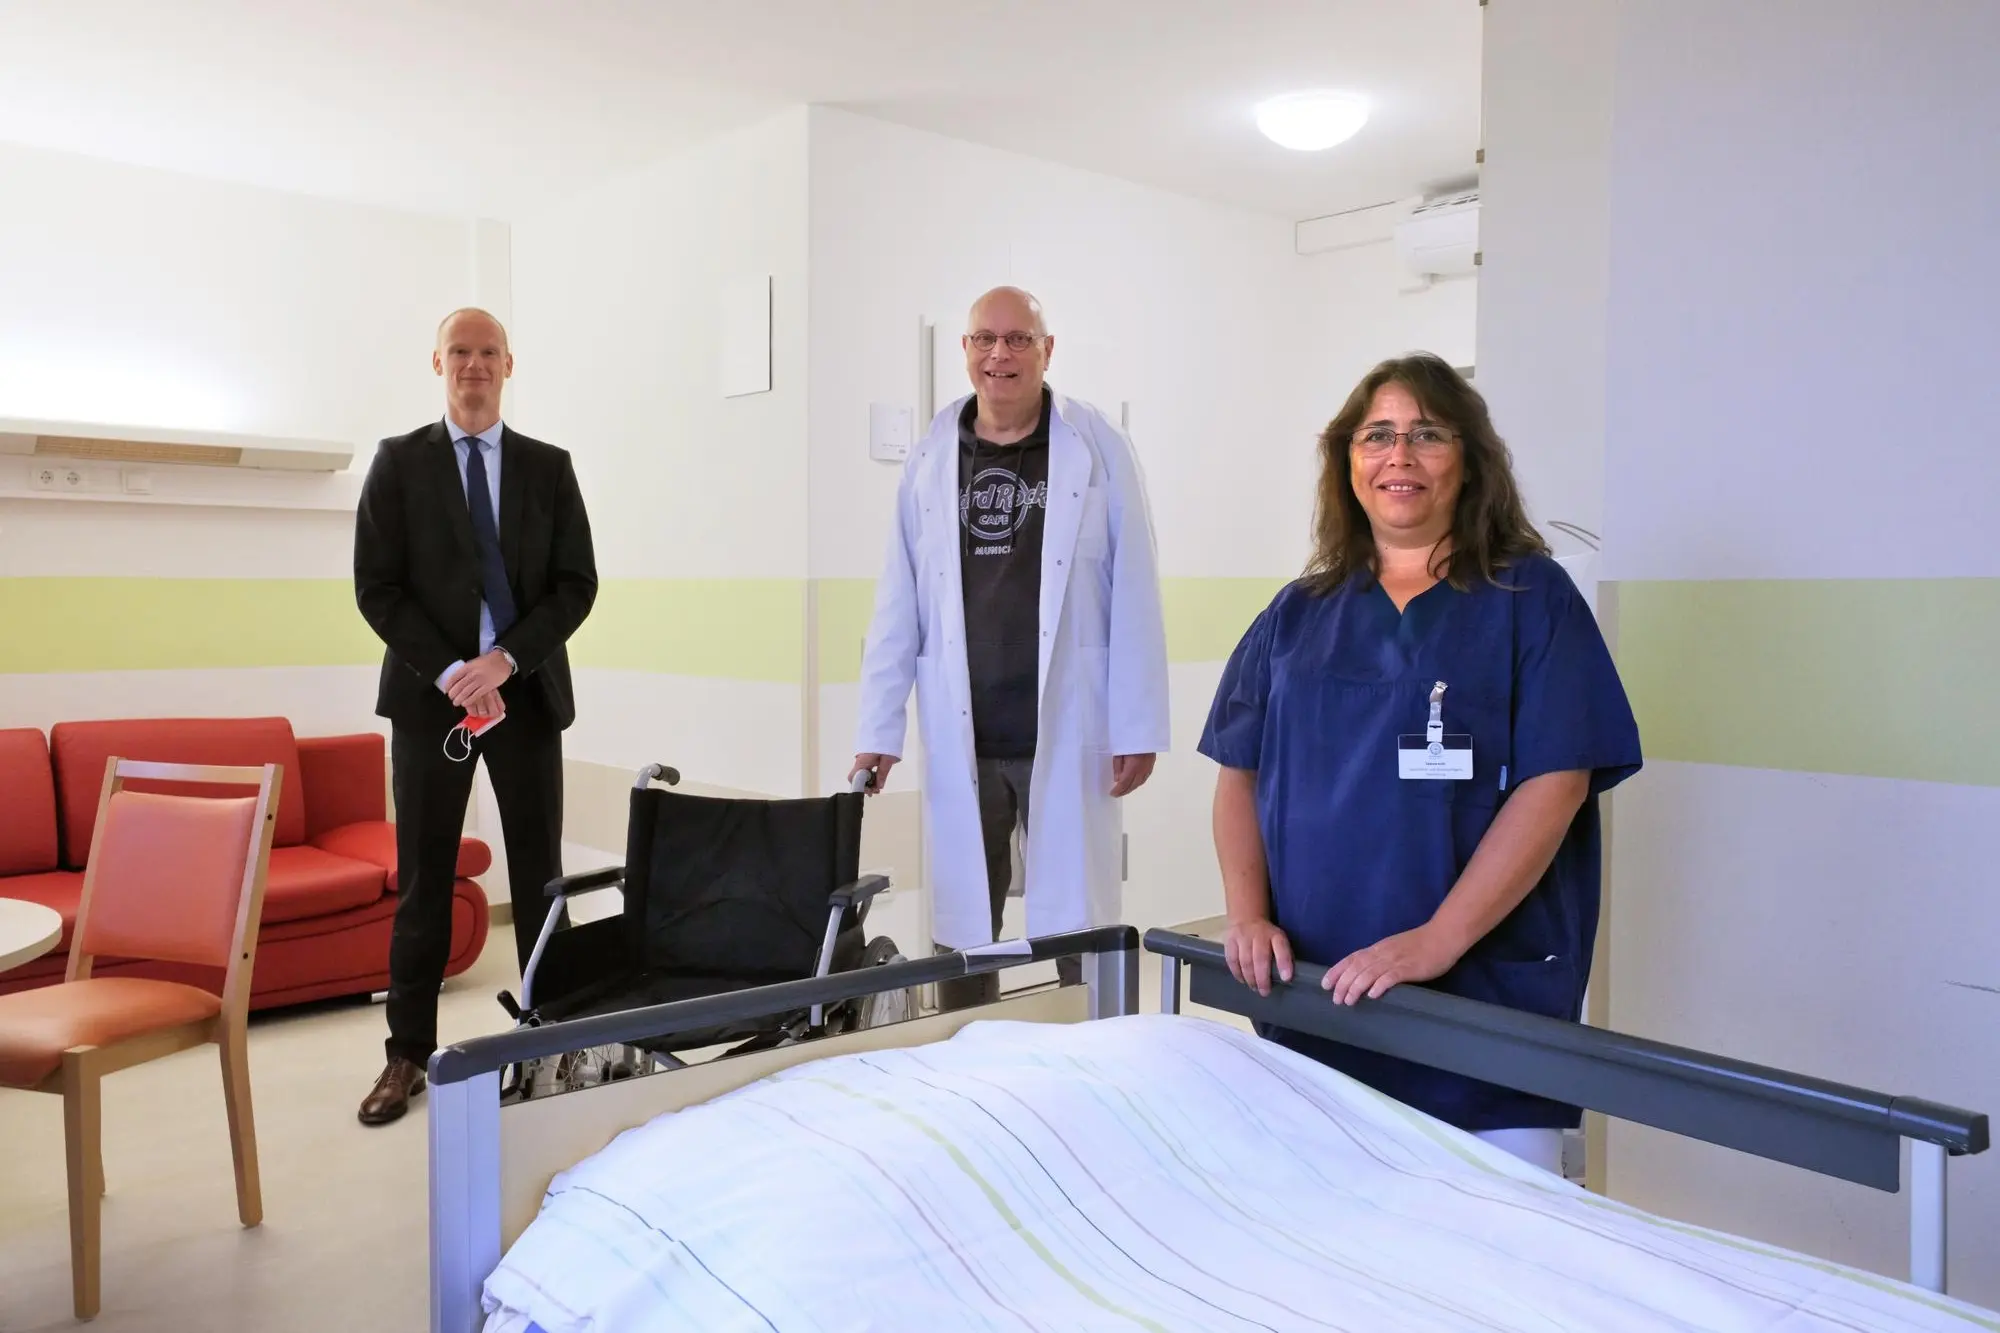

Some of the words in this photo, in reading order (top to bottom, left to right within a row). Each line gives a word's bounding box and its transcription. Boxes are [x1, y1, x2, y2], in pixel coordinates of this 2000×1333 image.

[960, 484, 996, 509] ard
[995, 481, 1047, 513] Rock
[979, 515, 1009, 525] CAFE
